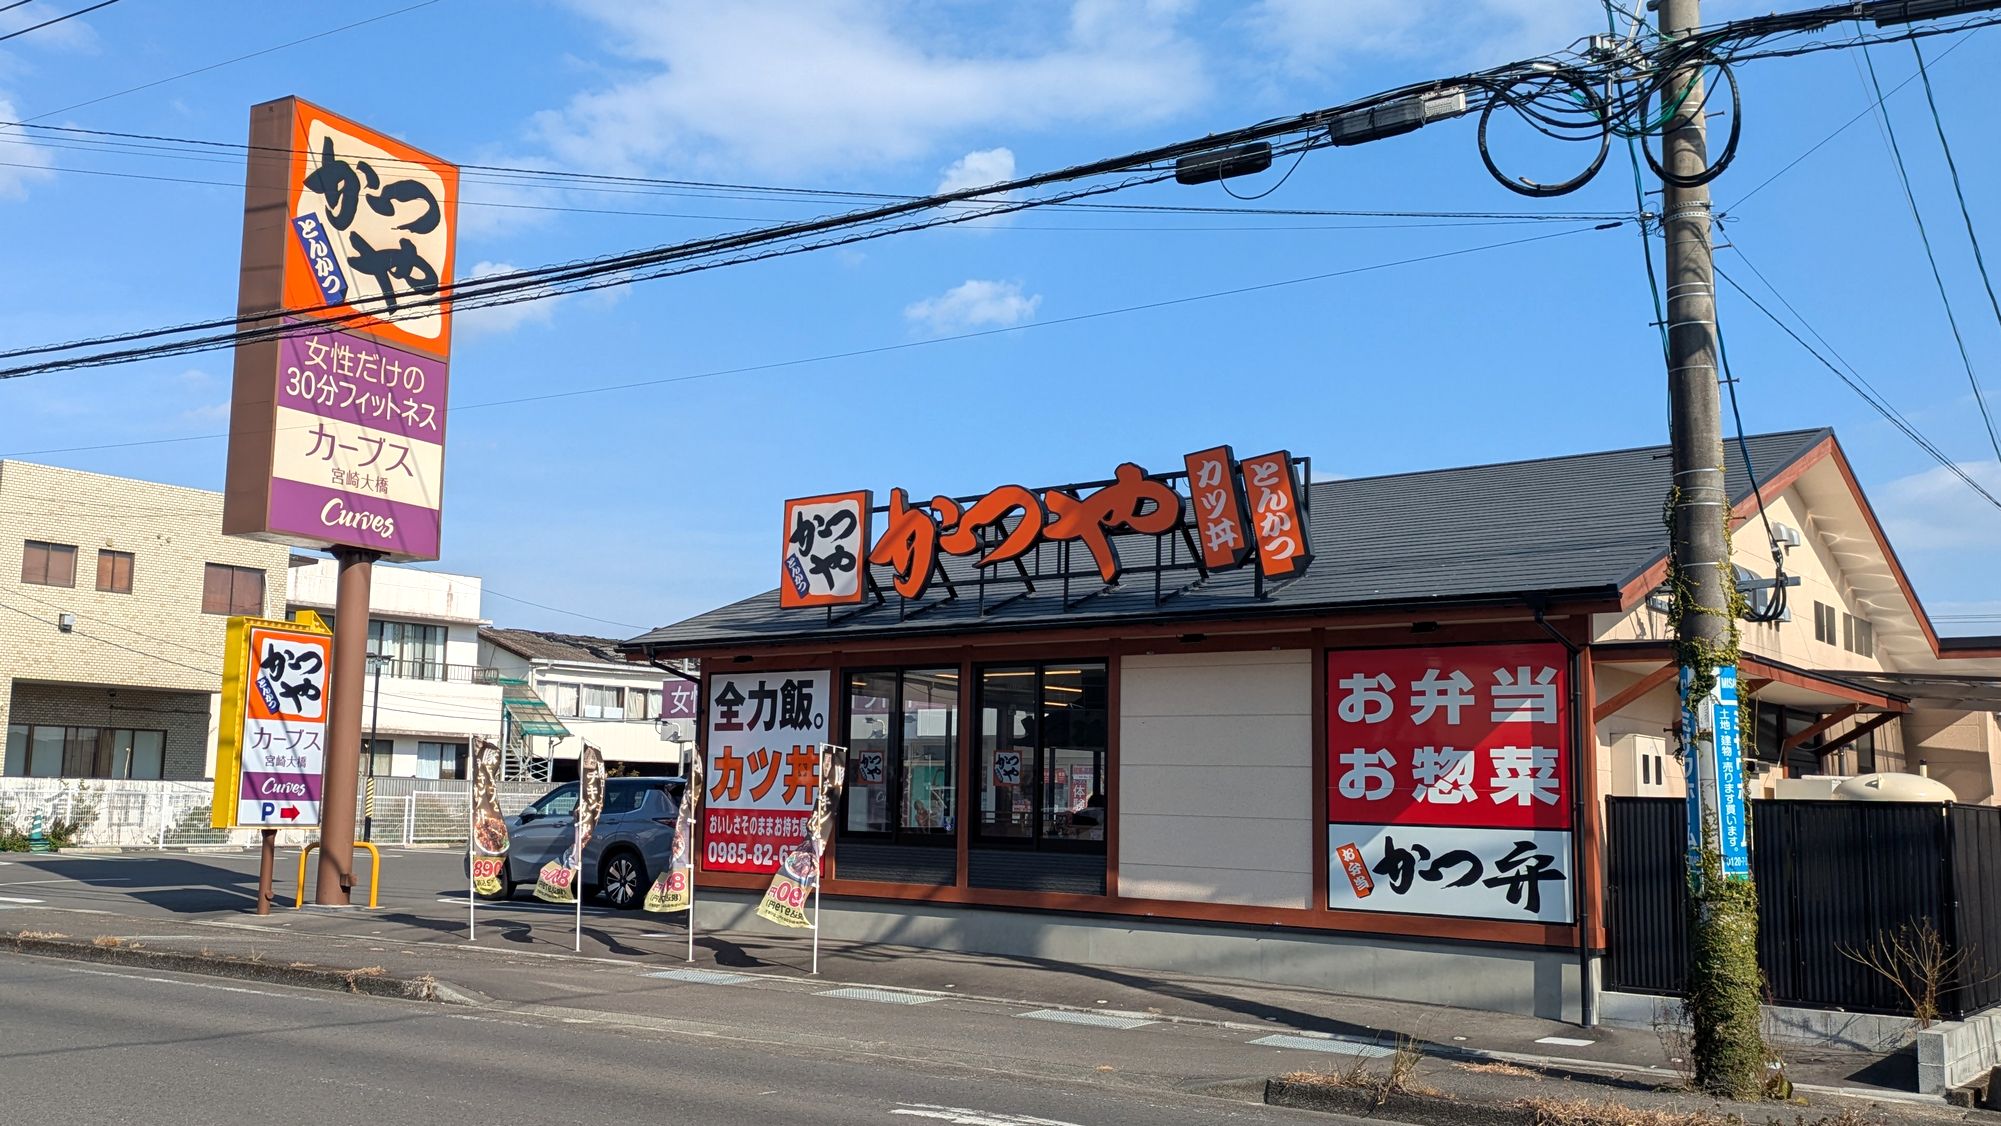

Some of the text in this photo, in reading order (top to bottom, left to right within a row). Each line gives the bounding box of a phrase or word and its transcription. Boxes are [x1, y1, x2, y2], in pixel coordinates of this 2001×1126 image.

[297, 219, 341, 294] とんかつ
[304, 336, 425, 395] 女性だけの
[286, 367, 438, 432] 30分フィットネス
[305, 423, 414, 477] カーブス
[331, 466, 389, 495] 宮崎大橋
[1198, 460, 1236, 553] カツ丼
[320, 497, 394, 539] Curves
[870, 461, 1185, 599] かつや
[1251, 461, 1295, 560] とんかつ
[787, 557, 806, 593] とんかつ
[714, 679, 824, 731] 全力飯。
[1338, 665, 1558, 726] お弁当
[251, 727, 321, 750] カーブス
[265, 754, 307, 768] 宮崎大橋
[262, 777, 306, 796] Curves
[710, 745, 820, 805] カツ丼
[1338, 746, 1560, 807] お惣菜
[261, 802, 275, 821] P
[1342, 847, 1370, 890] お弁当
[1373, 836, 1567, 913] かつ弁
